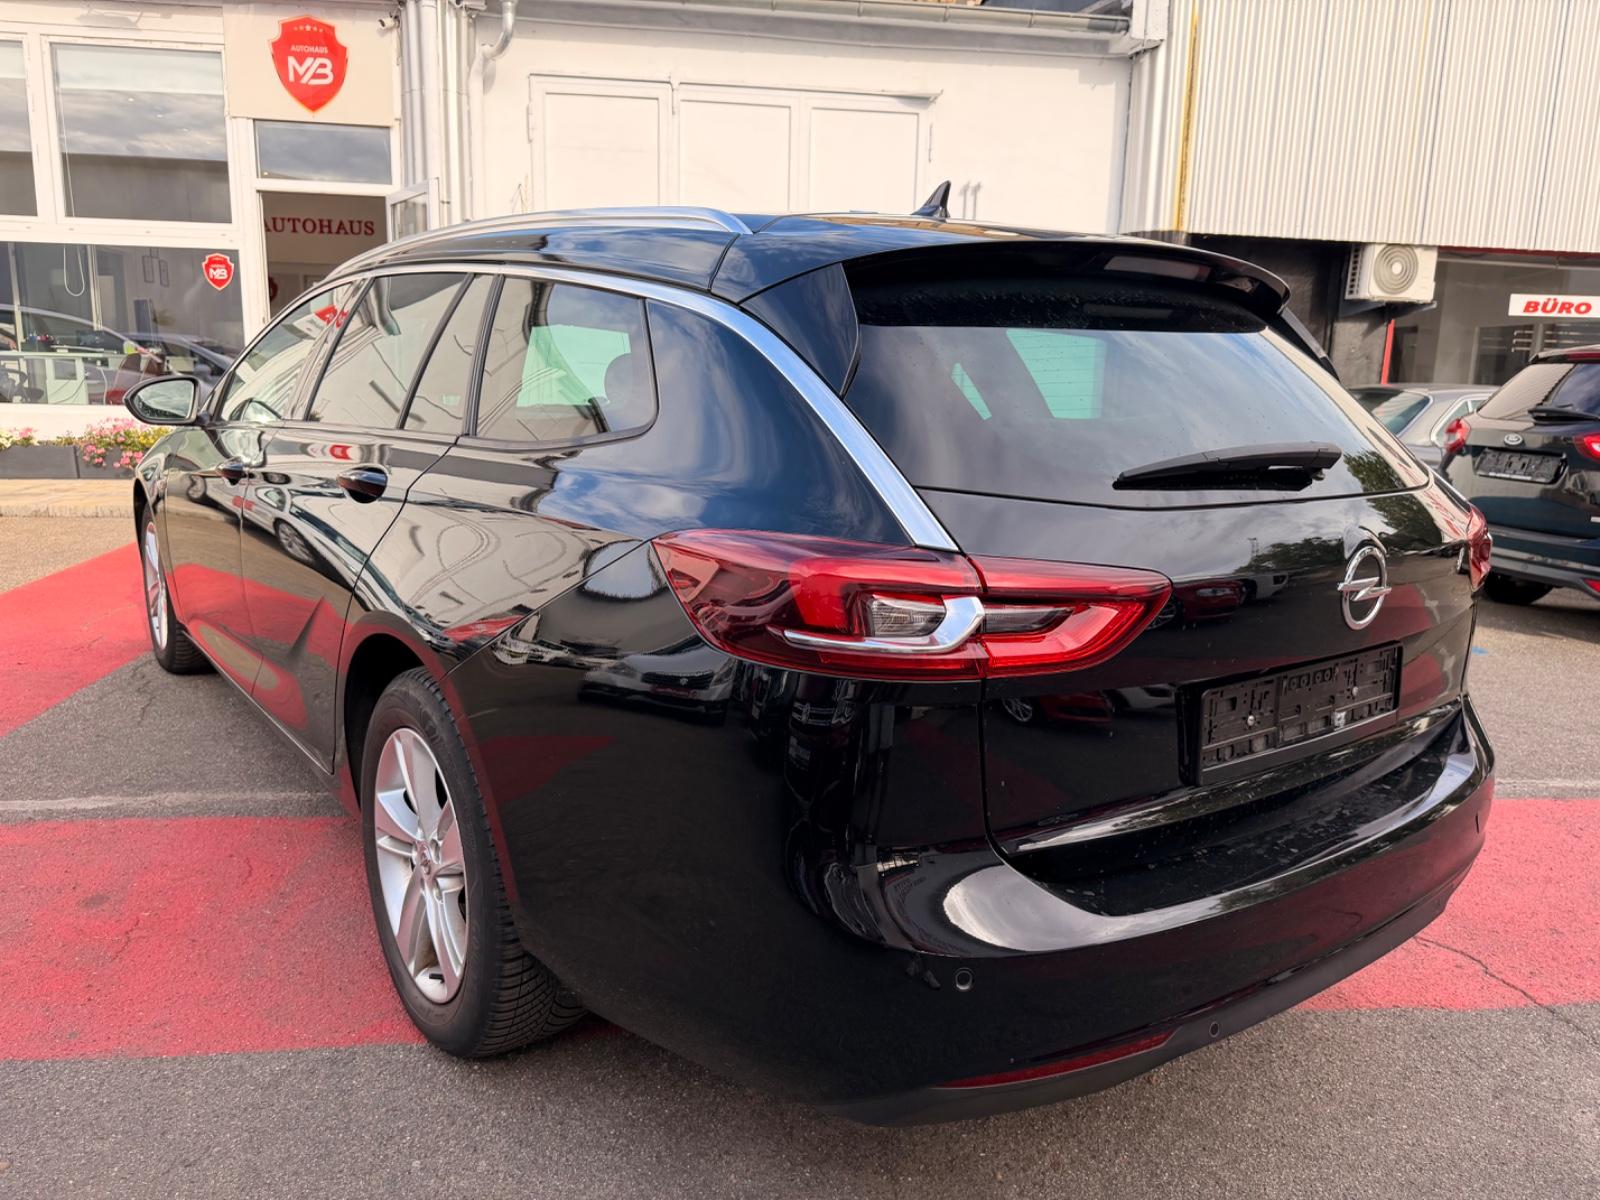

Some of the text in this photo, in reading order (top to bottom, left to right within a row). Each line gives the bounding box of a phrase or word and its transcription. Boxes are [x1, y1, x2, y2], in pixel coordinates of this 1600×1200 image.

[290, 44, 328, 54] AUTOHAUS
[287, 55, 334, 86] MB
[209, 267, 228, 280] MB
[1523, 297, 1592, 315] BÜRO
